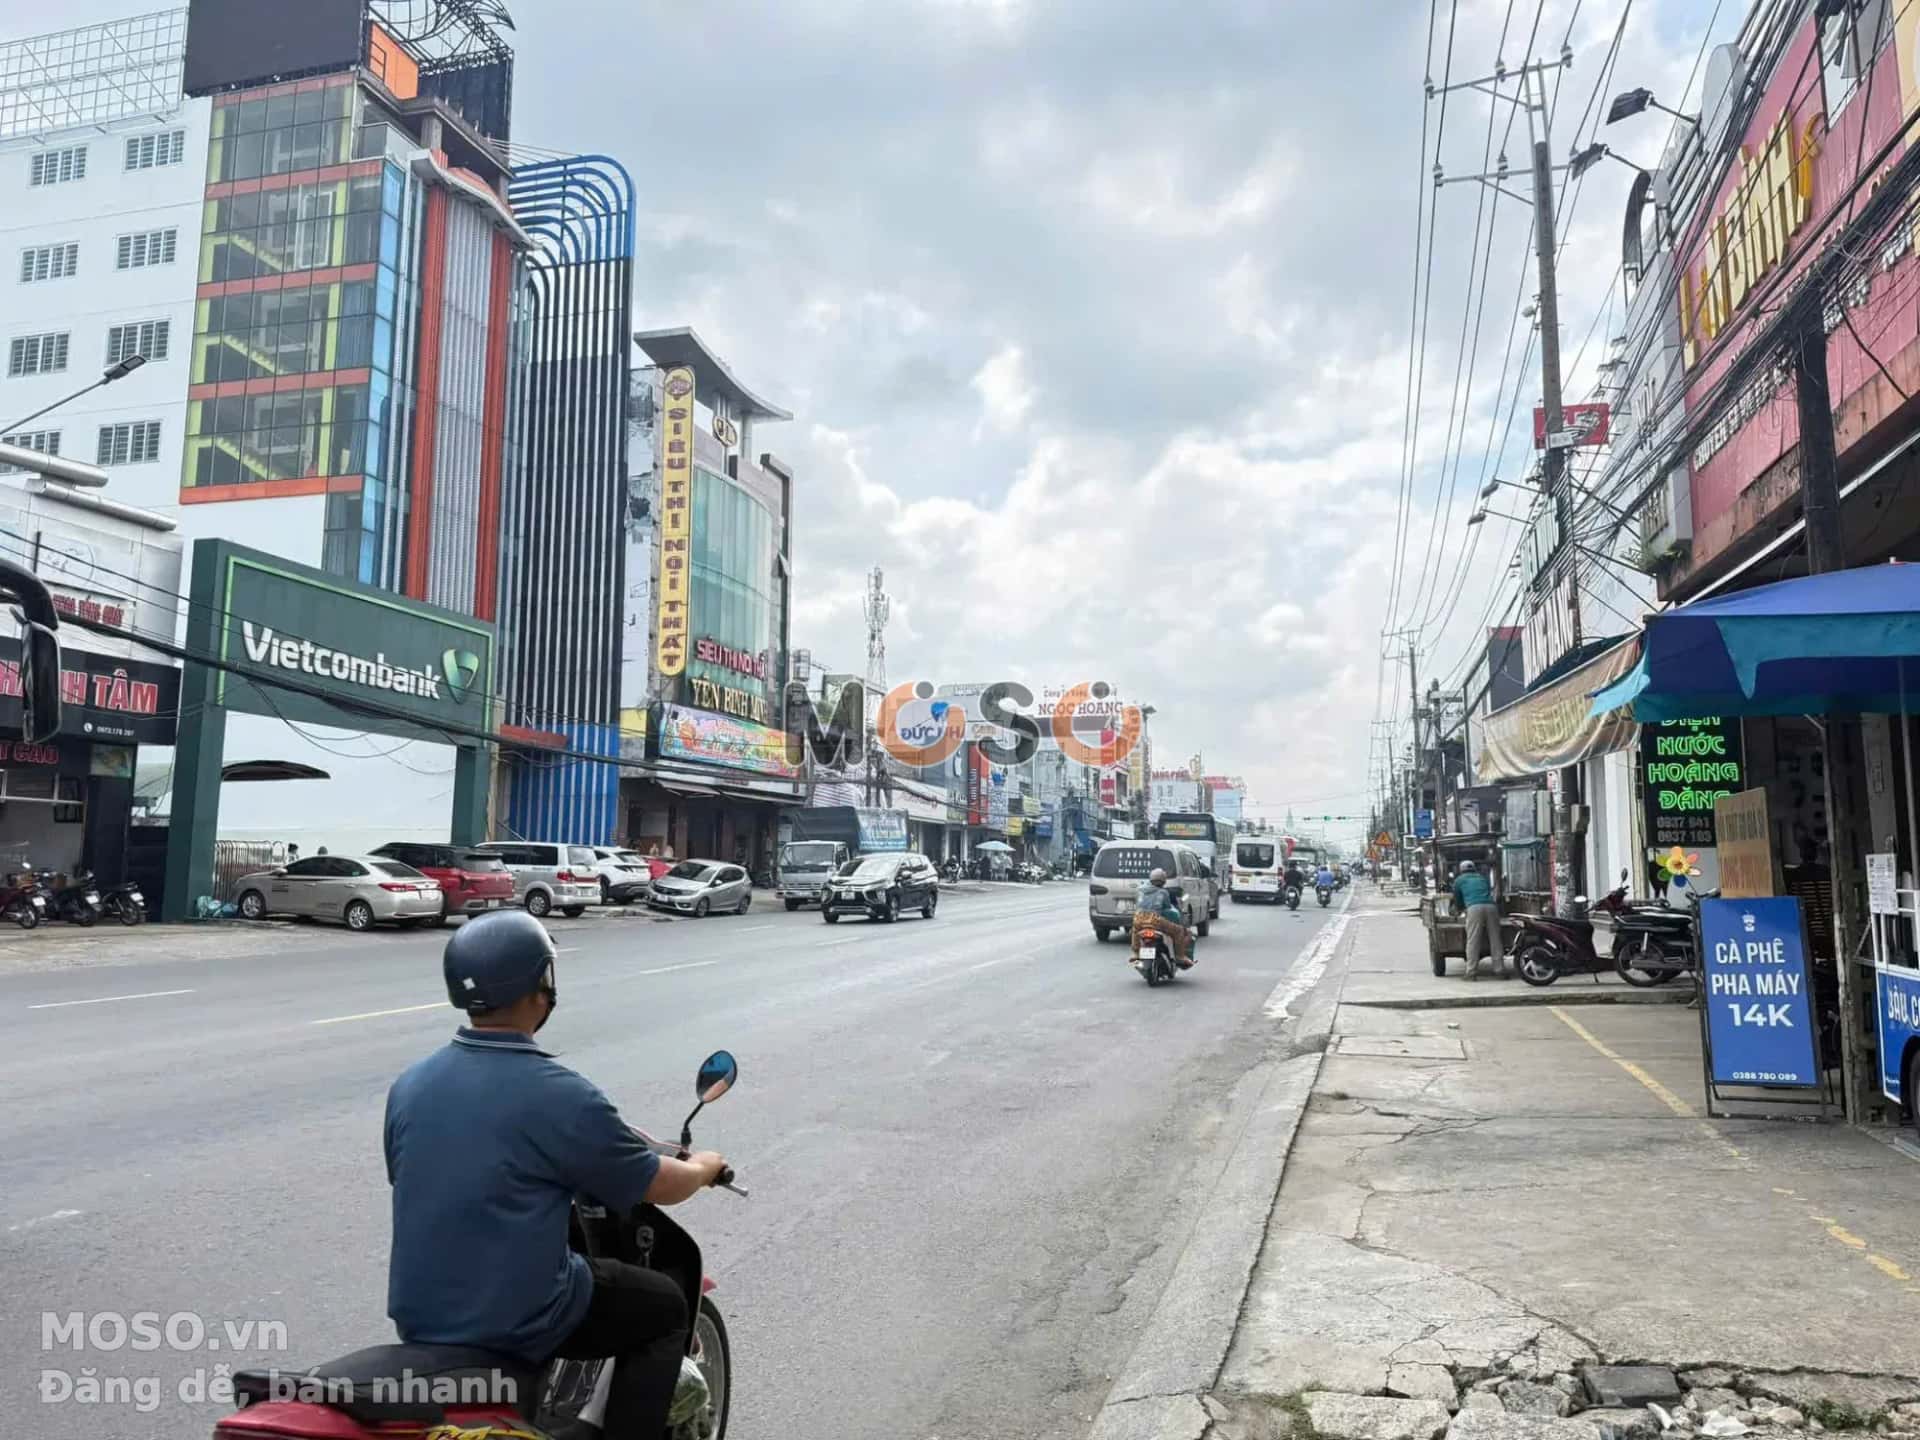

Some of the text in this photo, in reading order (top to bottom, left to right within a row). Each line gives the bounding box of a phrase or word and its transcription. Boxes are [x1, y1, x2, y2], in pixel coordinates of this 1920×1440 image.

[242, 620, 441, 700] Vietcombank
[93, 668, 158, 714] TÂM
[1656, 732, 1726, 755] NƯỚC
[1648, 759, 1739, 784] HOÀNG
[1715, 937, 1786, 964] CÀ PHÊ
[1711, 969, 1800, 996] PHA MÁY
[1728, 1003, 1794, 1027] 14K
